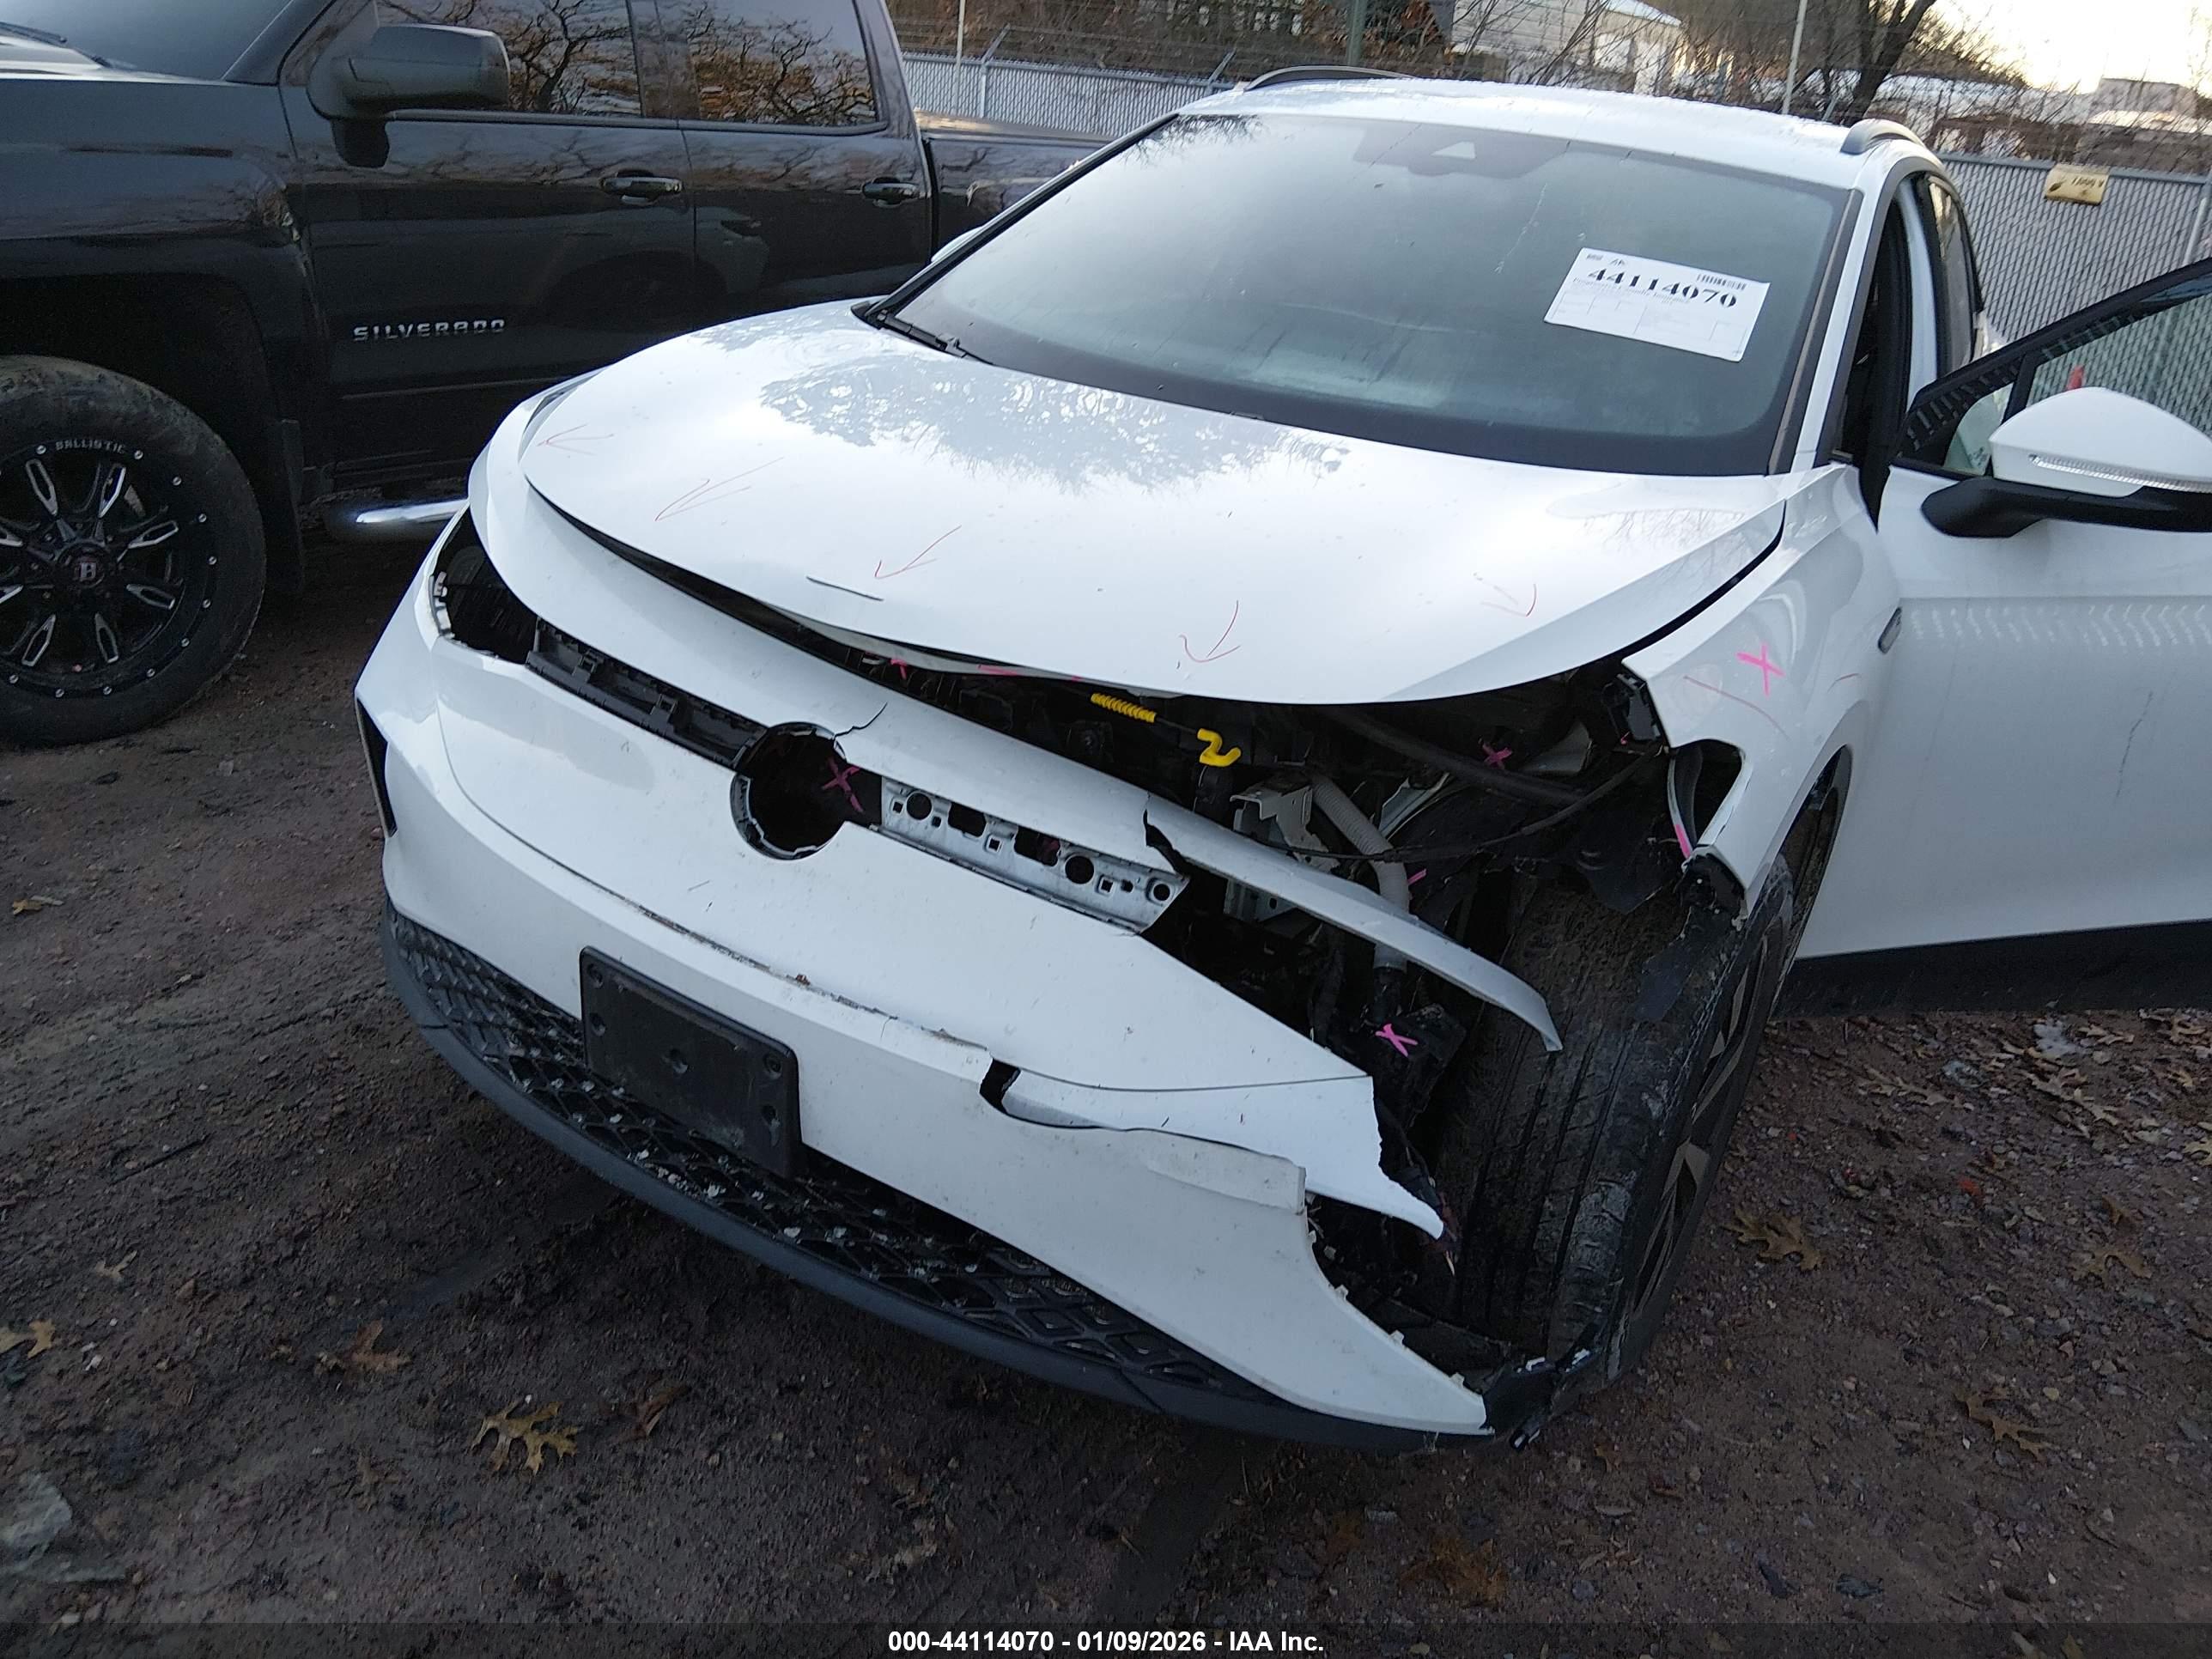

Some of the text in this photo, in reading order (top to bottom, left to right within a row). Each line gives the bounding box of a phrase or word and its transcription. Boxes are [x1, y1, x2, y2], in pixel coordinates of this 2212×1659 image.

[1589, 268, 1737, 308] 44114070
[353, 319, 506, 342] SILVERADO
[55, 438, 125, 454] BALLISTIC
